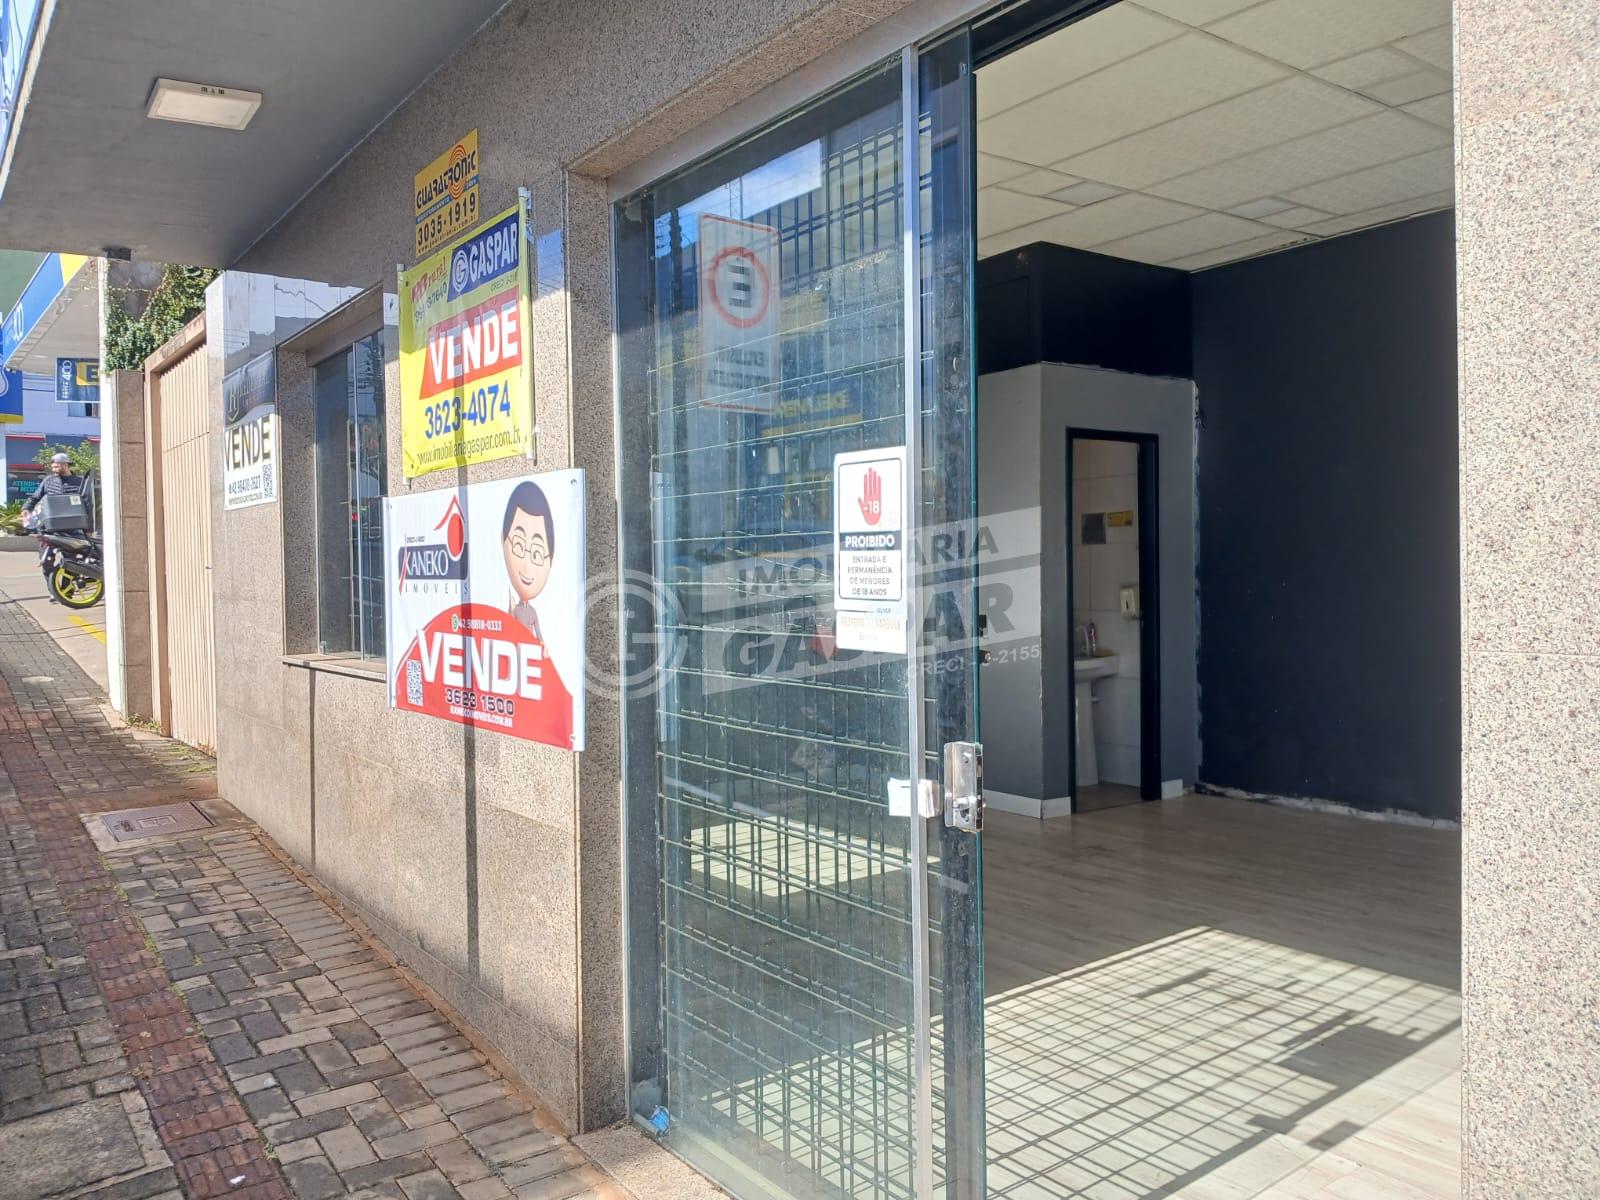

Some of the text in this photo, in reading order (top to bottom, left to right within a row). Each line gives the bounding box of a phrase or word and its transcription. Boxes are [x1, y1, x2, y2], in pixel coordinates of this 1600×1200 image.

[469, 222, 518, 282] GASPAR
[429, 299, 518, 385] VENDE
[425, 380, 510, 439] 3623-4074
[225, 414, 271, 471] VENDE
[845, 534, 894, 548] PROIBIDO
[403, 549, 449, 577] KANEKO
[847, 565, 893, 574] PERMANÊNCIA
[853, 555, 887, 564] ENTRADA E
[850, 577, 890, 585] DE MENORES
[869, 588, 887, 596] ANOS
[417, 630, 543, 700] VENDE
[446, 688, 515, 716] 3623 1500
